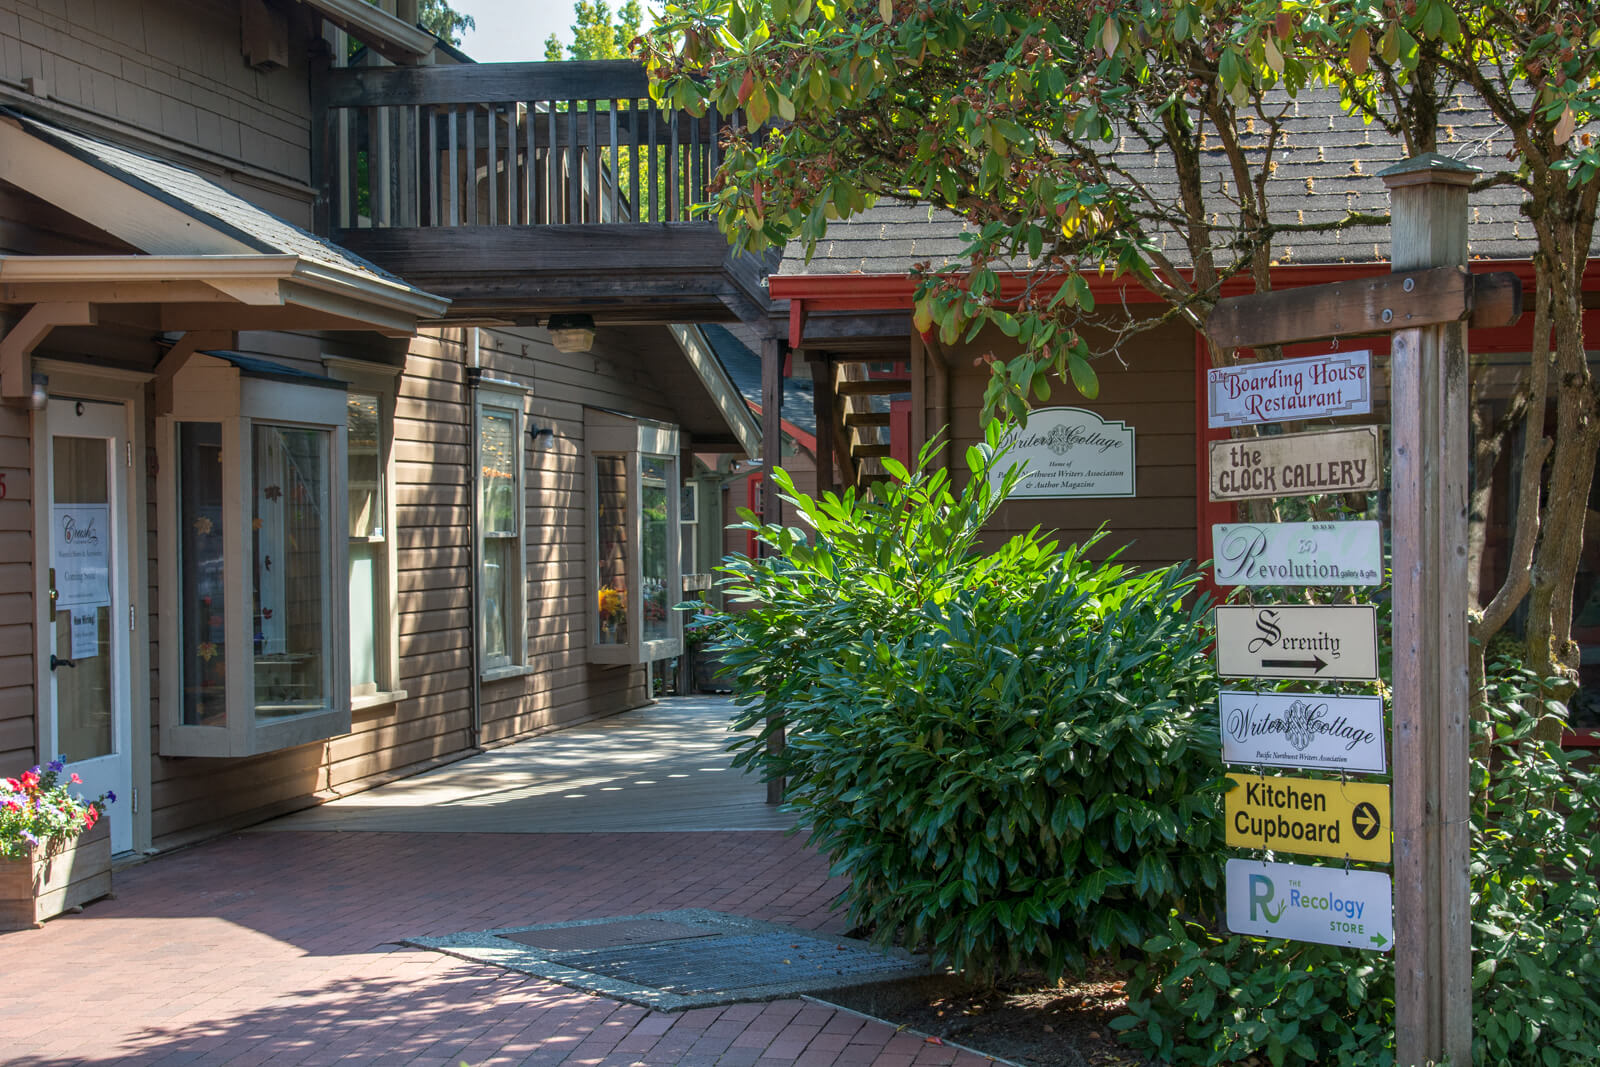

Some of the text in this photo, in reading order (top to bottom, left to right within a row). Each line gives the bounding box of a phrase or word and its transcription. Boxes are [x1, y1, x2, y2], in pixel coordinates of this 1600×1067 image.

[1210, 360, 1366, 399] The Boarding House
[1245, 388, 1342, 421] Restaurant
[1066, 461, 1072, 469] of
[1230, 444, 1262, 468] the
[1058, 470, 1084, 478] Writers
[1060, 481, 1095, 489] Magazine
[1219, 466, 1278, 493] CLOCK
[1217, 526, 1340, 579] Revolution
[1359, 569, 1365, 577] &
[1248, 609, 1341, 659] Serenity
[1256, 751, 1348, 763] Pacific Northwest Writers Association
[1246, 782, 1327, 812] Kitchen
[1235, 811, 1341, 844] Cupboard
[1289, 879, 1302, 888] THE
[1290, 888, 1365, 920] Recology
[1330, 920, 1365, 935] STORE
